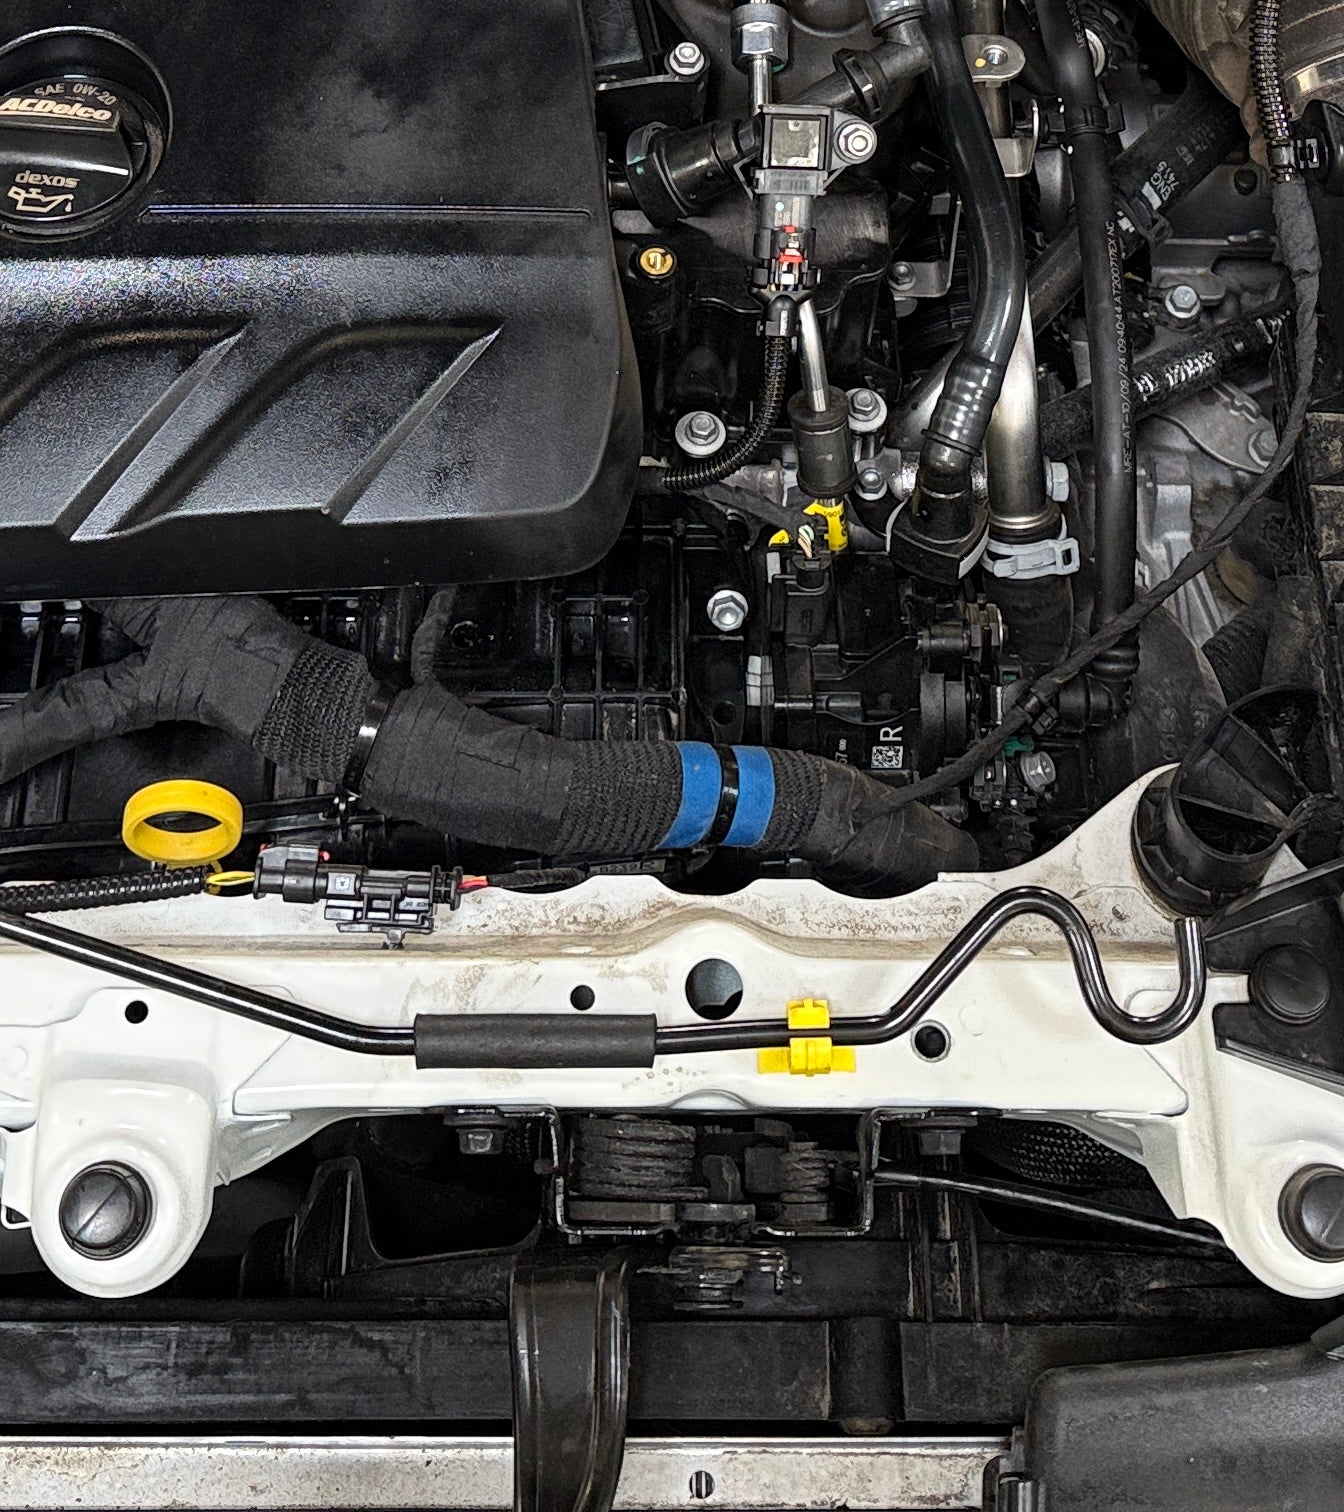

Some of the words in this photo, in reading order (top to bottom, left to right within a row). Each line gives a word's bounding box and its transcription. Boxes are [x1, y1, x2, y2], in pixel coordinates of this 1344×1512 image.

[34, 82, 65, 96] SAE
[72, 81, 118, 106] 0W-20
[14, 170, 81, 189] dexos
[1150, 172, 1172, 201] ENG
[879, 725, 904, 742] R
